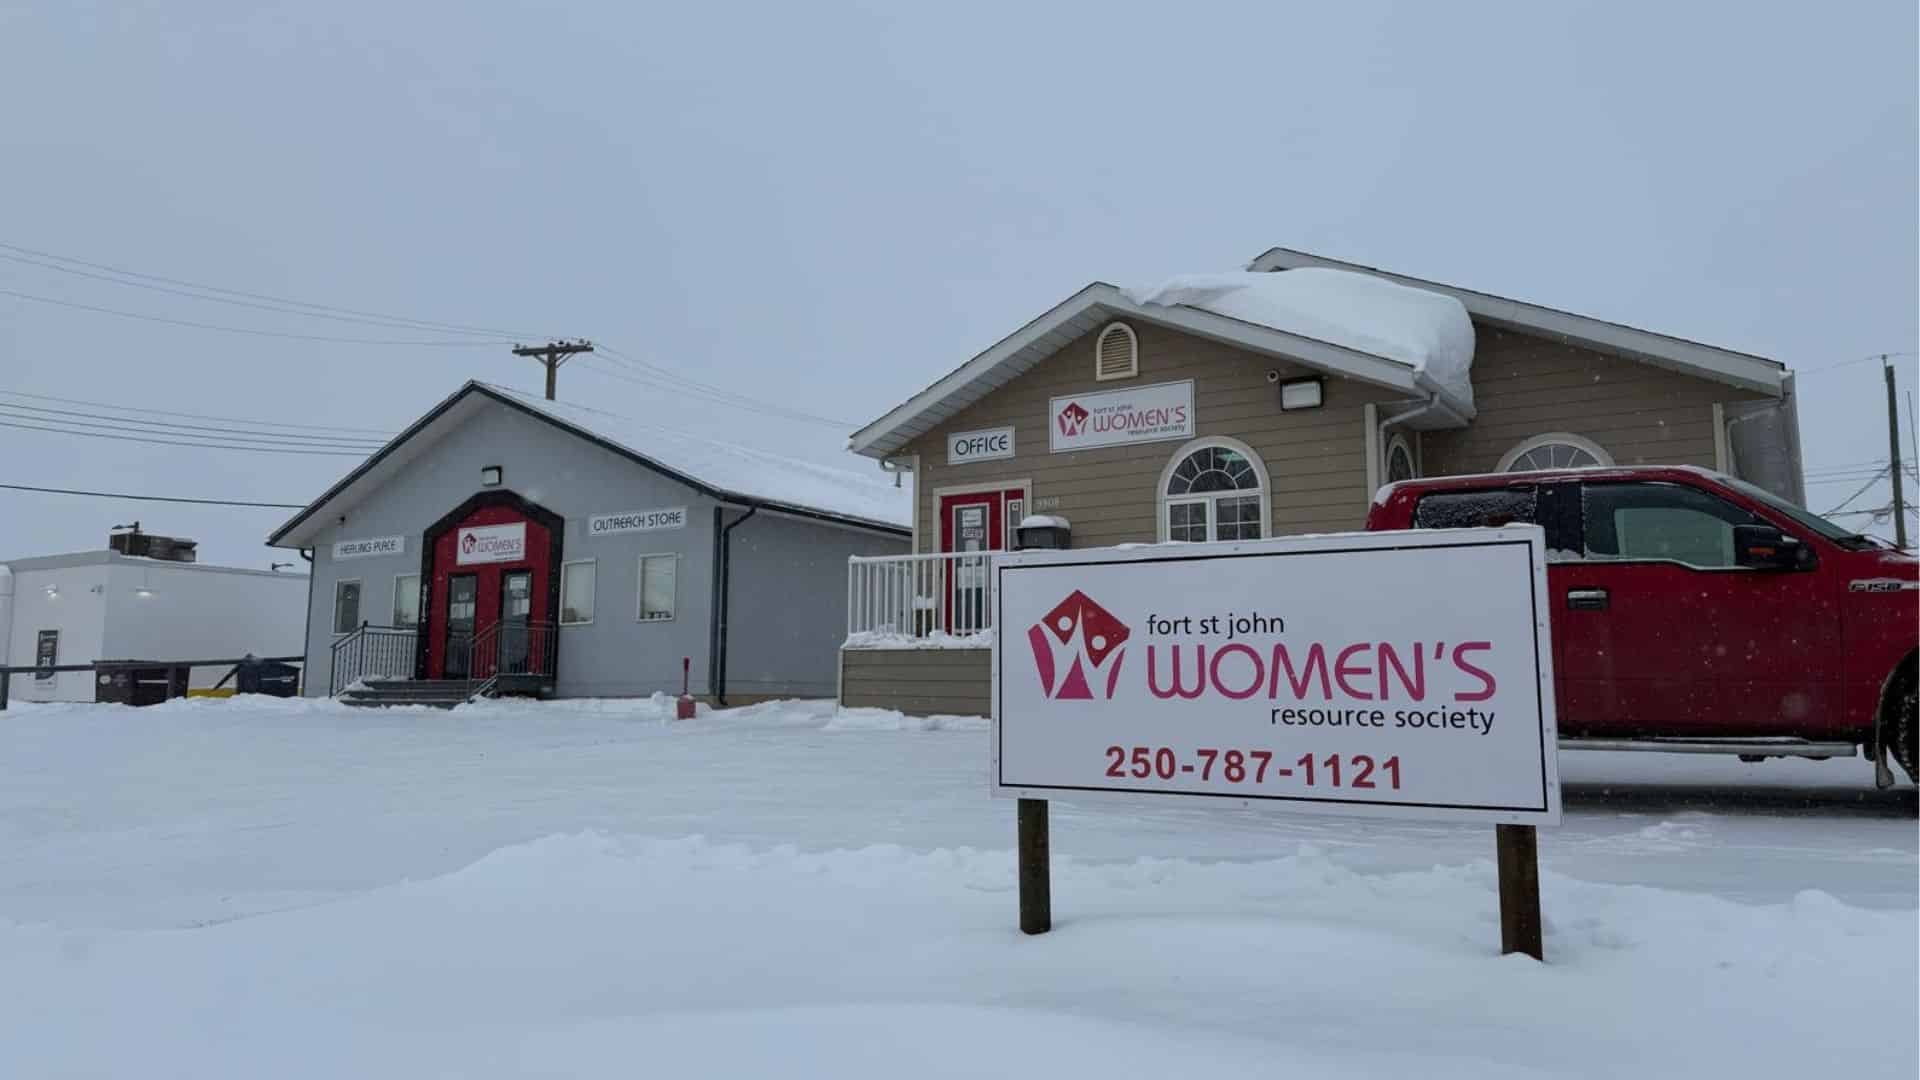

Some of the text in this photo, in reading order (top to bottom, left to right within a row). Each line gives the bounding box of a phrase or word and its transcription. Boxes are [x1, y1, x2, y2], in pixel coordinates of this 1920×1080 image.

[1092, 405, 1186, 433] WOMEN'S
[955, 434, 1008, 456] OFFICE
[593, 511, 681, 531] OUTREACH STORE
[1147, 611, 1285, 640] fort st john
[1147, 641, 1497, 701] WOMEN'S
[1271, 704, 1496, 736] resource society
[1105, 746, 1401, 790] 250-787-1121
